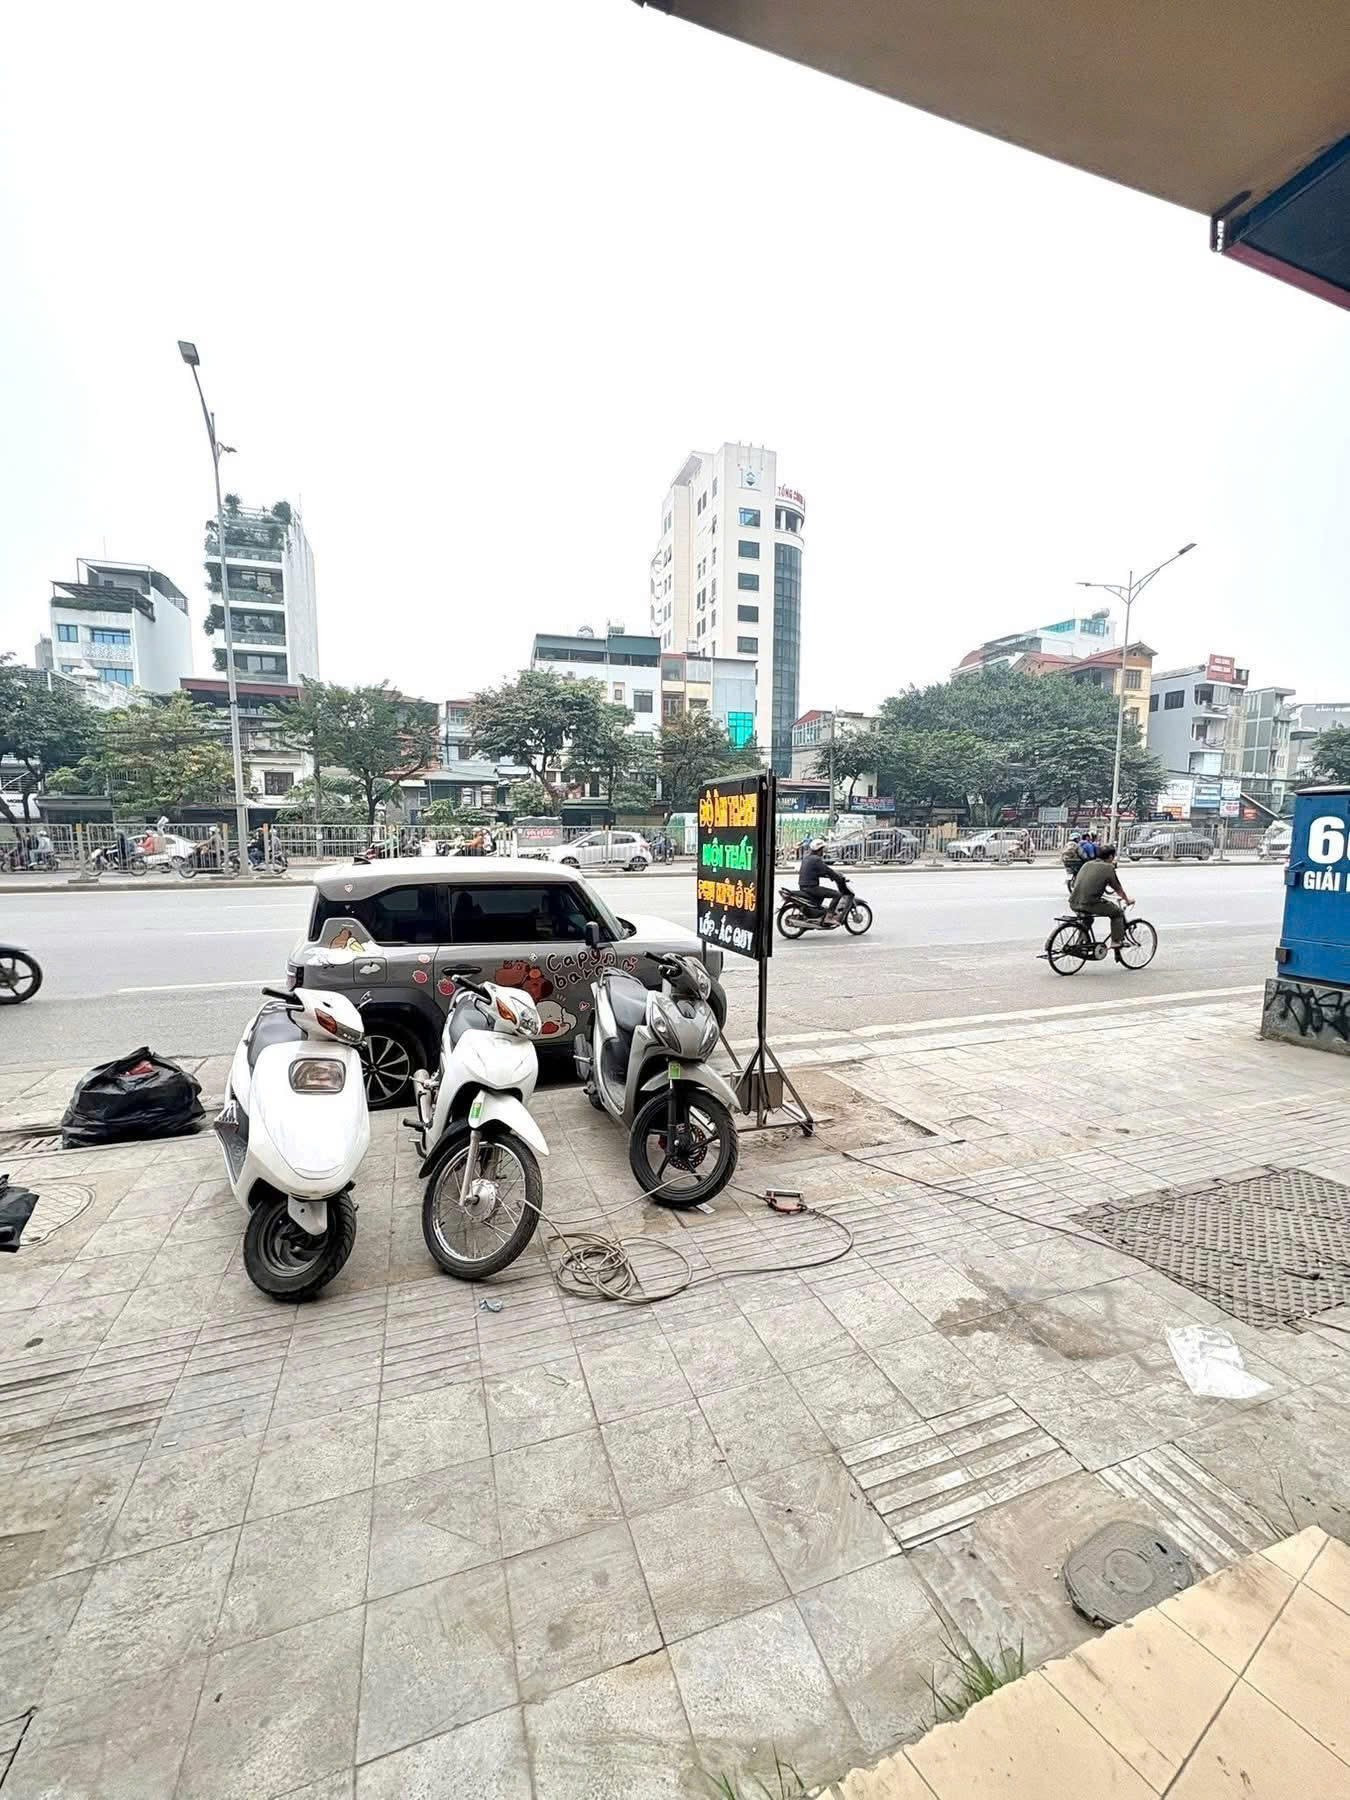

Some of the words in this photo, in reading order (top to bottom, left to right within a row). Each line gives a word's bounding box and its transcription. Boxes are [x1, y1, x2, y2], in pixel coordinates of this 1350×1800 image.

[699, 789, 713, 834] ĐỘ
[702, 836, 723, 872] NỘI
[724, 834, 753, 870] THẤT
[1308, 815, 1350, 864] 6
[1303, 865, 1341, 892] GIẢI
[732, 927, 753, 950] QUY
